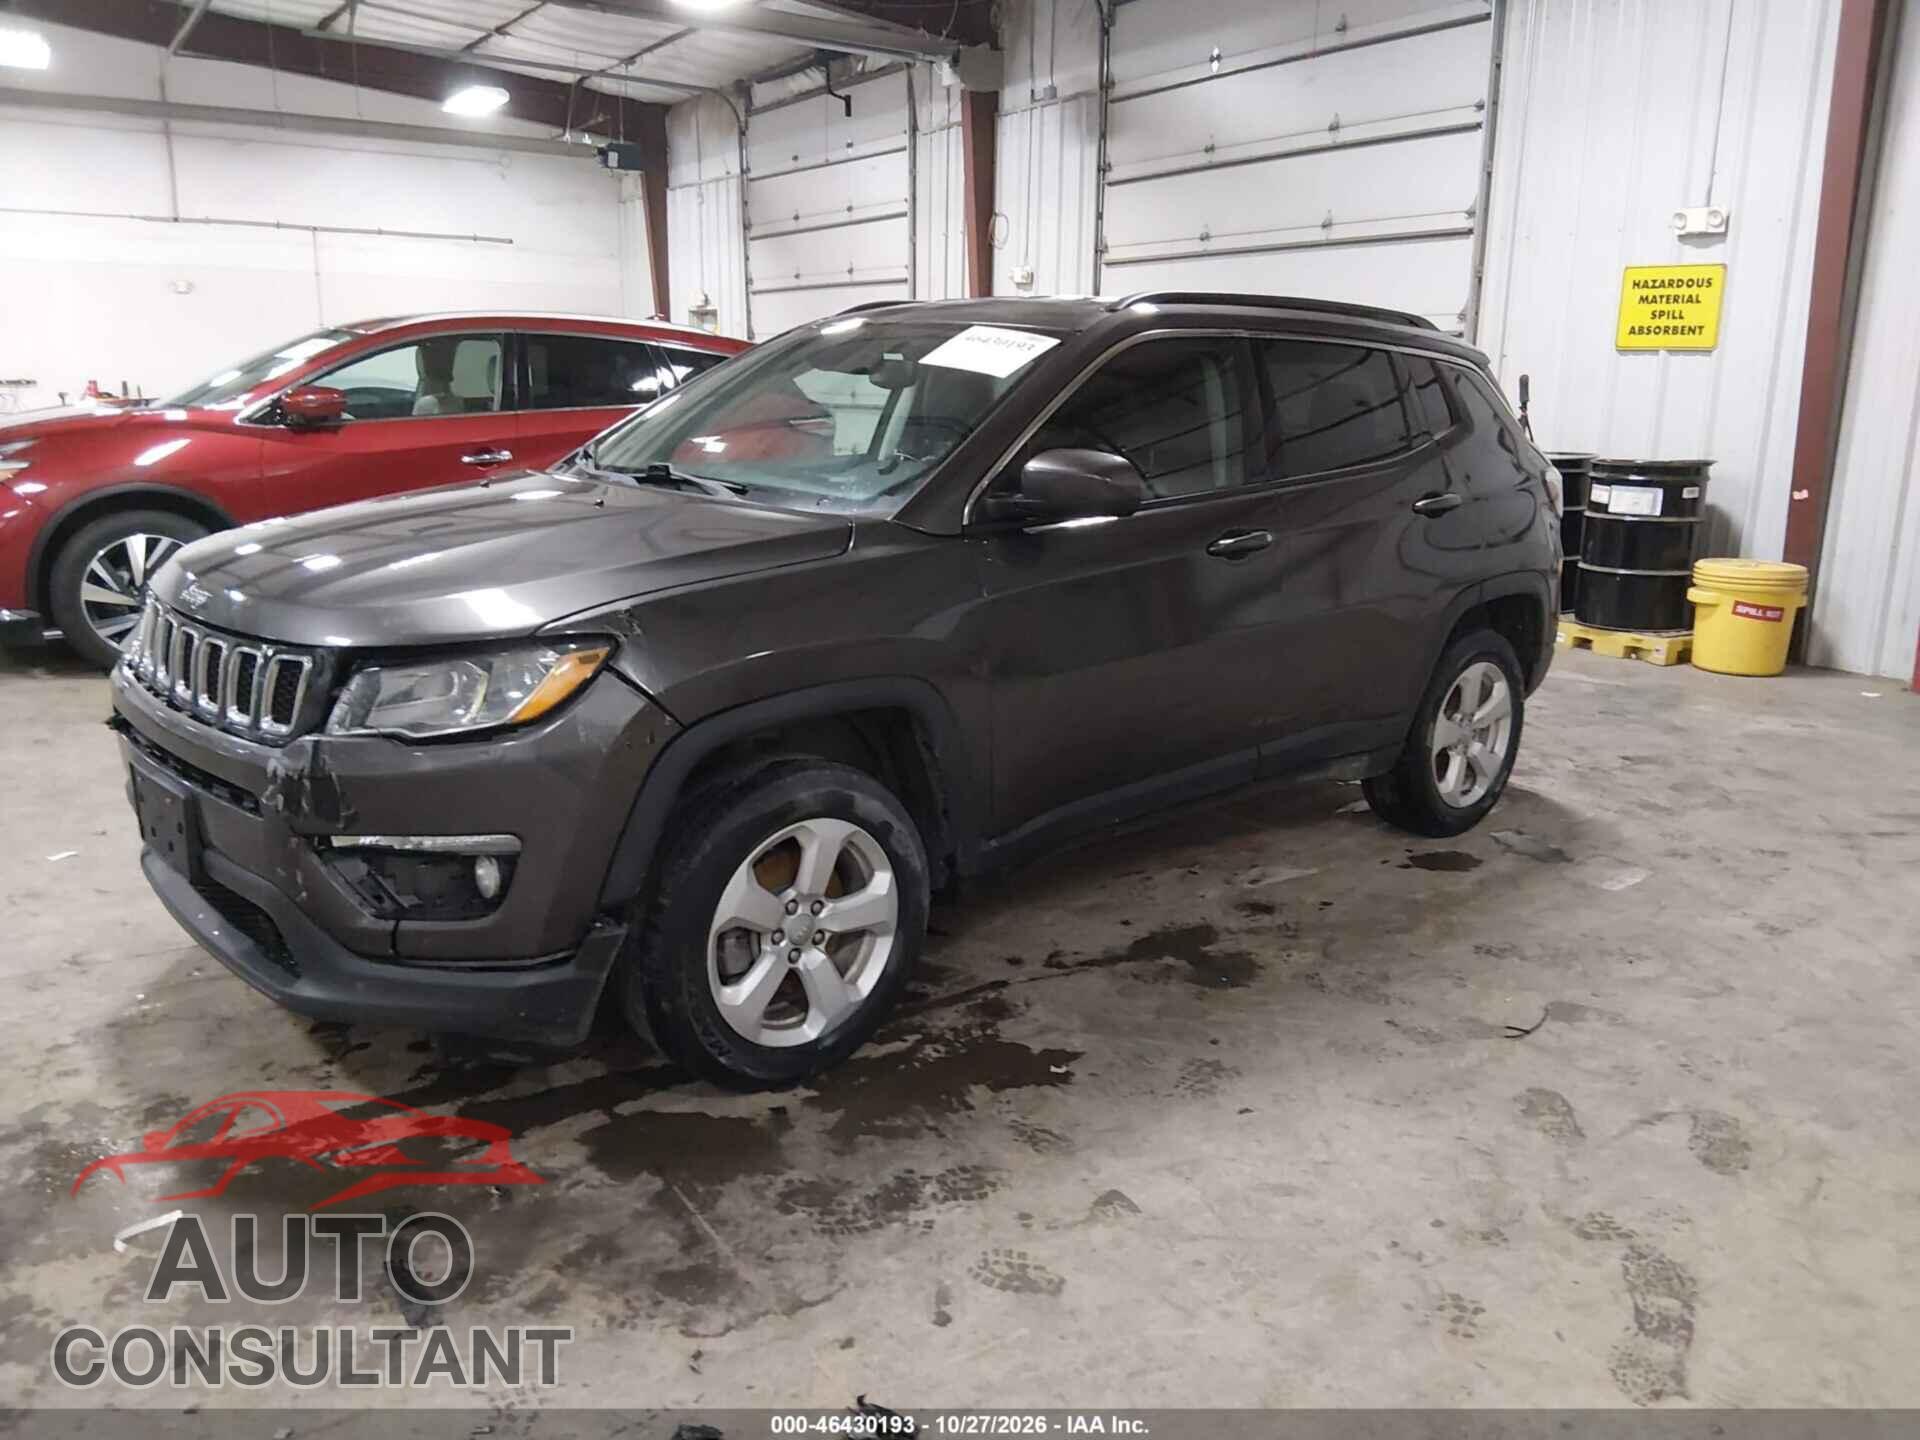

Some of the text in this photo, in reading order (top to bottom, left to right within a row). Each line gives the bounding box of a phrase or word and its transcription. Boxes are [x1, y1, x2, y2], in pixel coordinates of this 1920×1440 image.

[1632, 277, 1713, 290] HAZARDOUS
[1638, 294, 1702, 305] MATERIAL
[1650, 309, 1685, 320] SPILL
[1628, 325, 1705, 336] ABSORBENT
